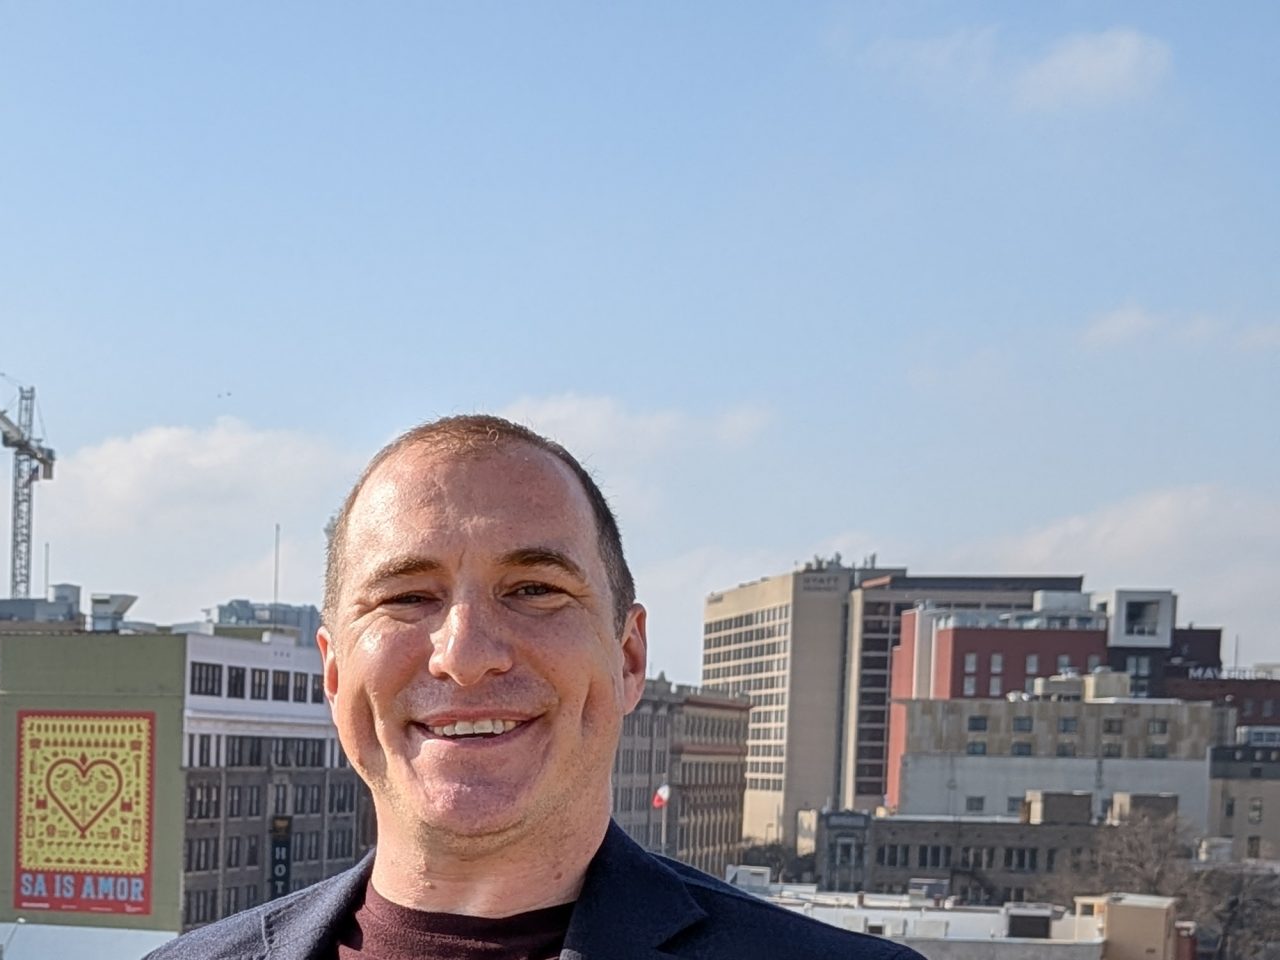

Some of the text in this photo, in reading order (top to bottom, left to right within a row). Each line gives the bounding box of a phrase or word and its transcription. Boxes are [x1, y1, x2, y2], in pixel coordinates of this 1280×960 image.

[21, 873, 145, 902] SA IS AMOR
